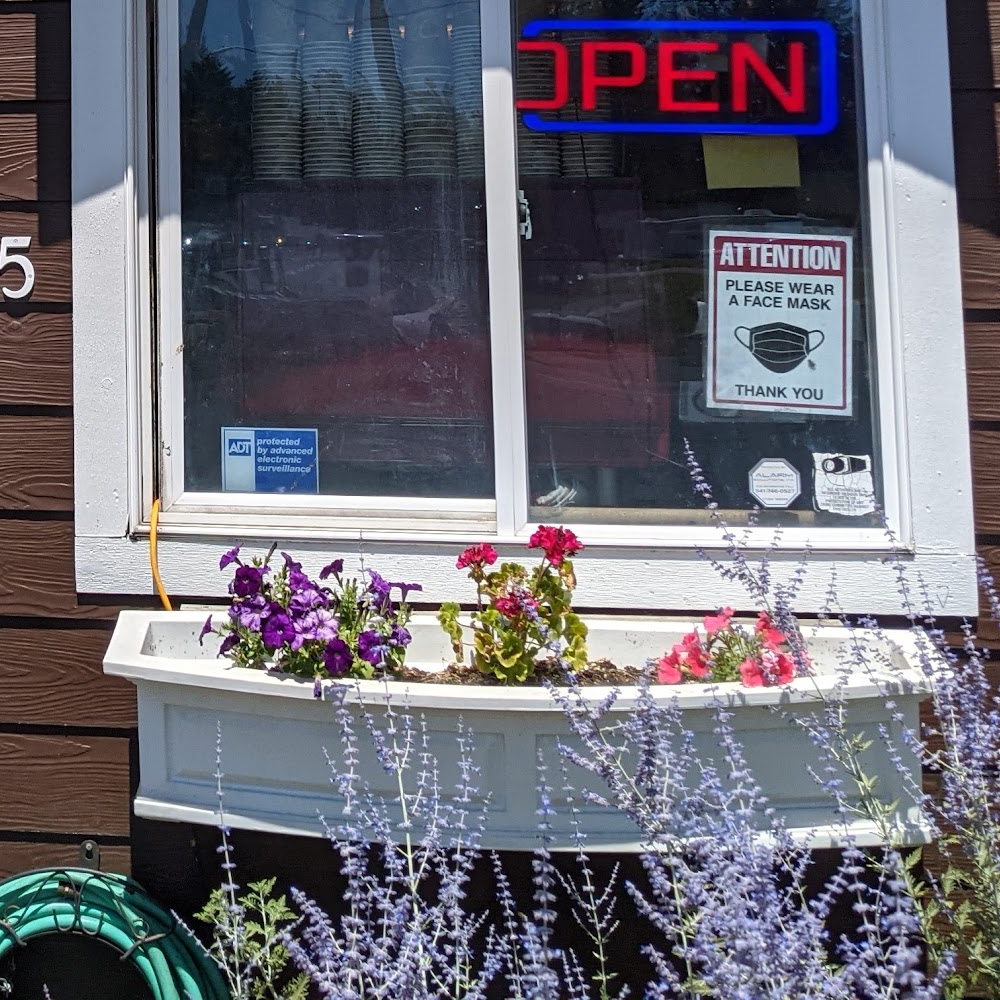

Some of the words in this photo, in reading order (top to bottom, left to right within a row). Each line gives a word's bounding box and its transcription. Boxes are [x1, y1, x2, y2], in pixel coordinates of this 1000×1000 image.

[515, 40, 806, 113] OPEN
[719, 242, 841, 271] ATTENTION
[725, 279, 784, 294] PLEASE
[789, 282, 835, 296] WEAR
[728, 294, 740, 306] A
[743, 295, 783, 309] FACE
[787, 297, 832, 311] MASK
[735, 384, 788, 399] THANK
[792, 387, 824, 401] YOU
[229, 441, 252, 454] ADT
[256, 437, 301, 447] protected
[256, 447, 268, 456] by
[270, 447, 314, 455] advanced
[257, 455, 302, 464] electronic
[257, 464, 312, 473] surveillance
